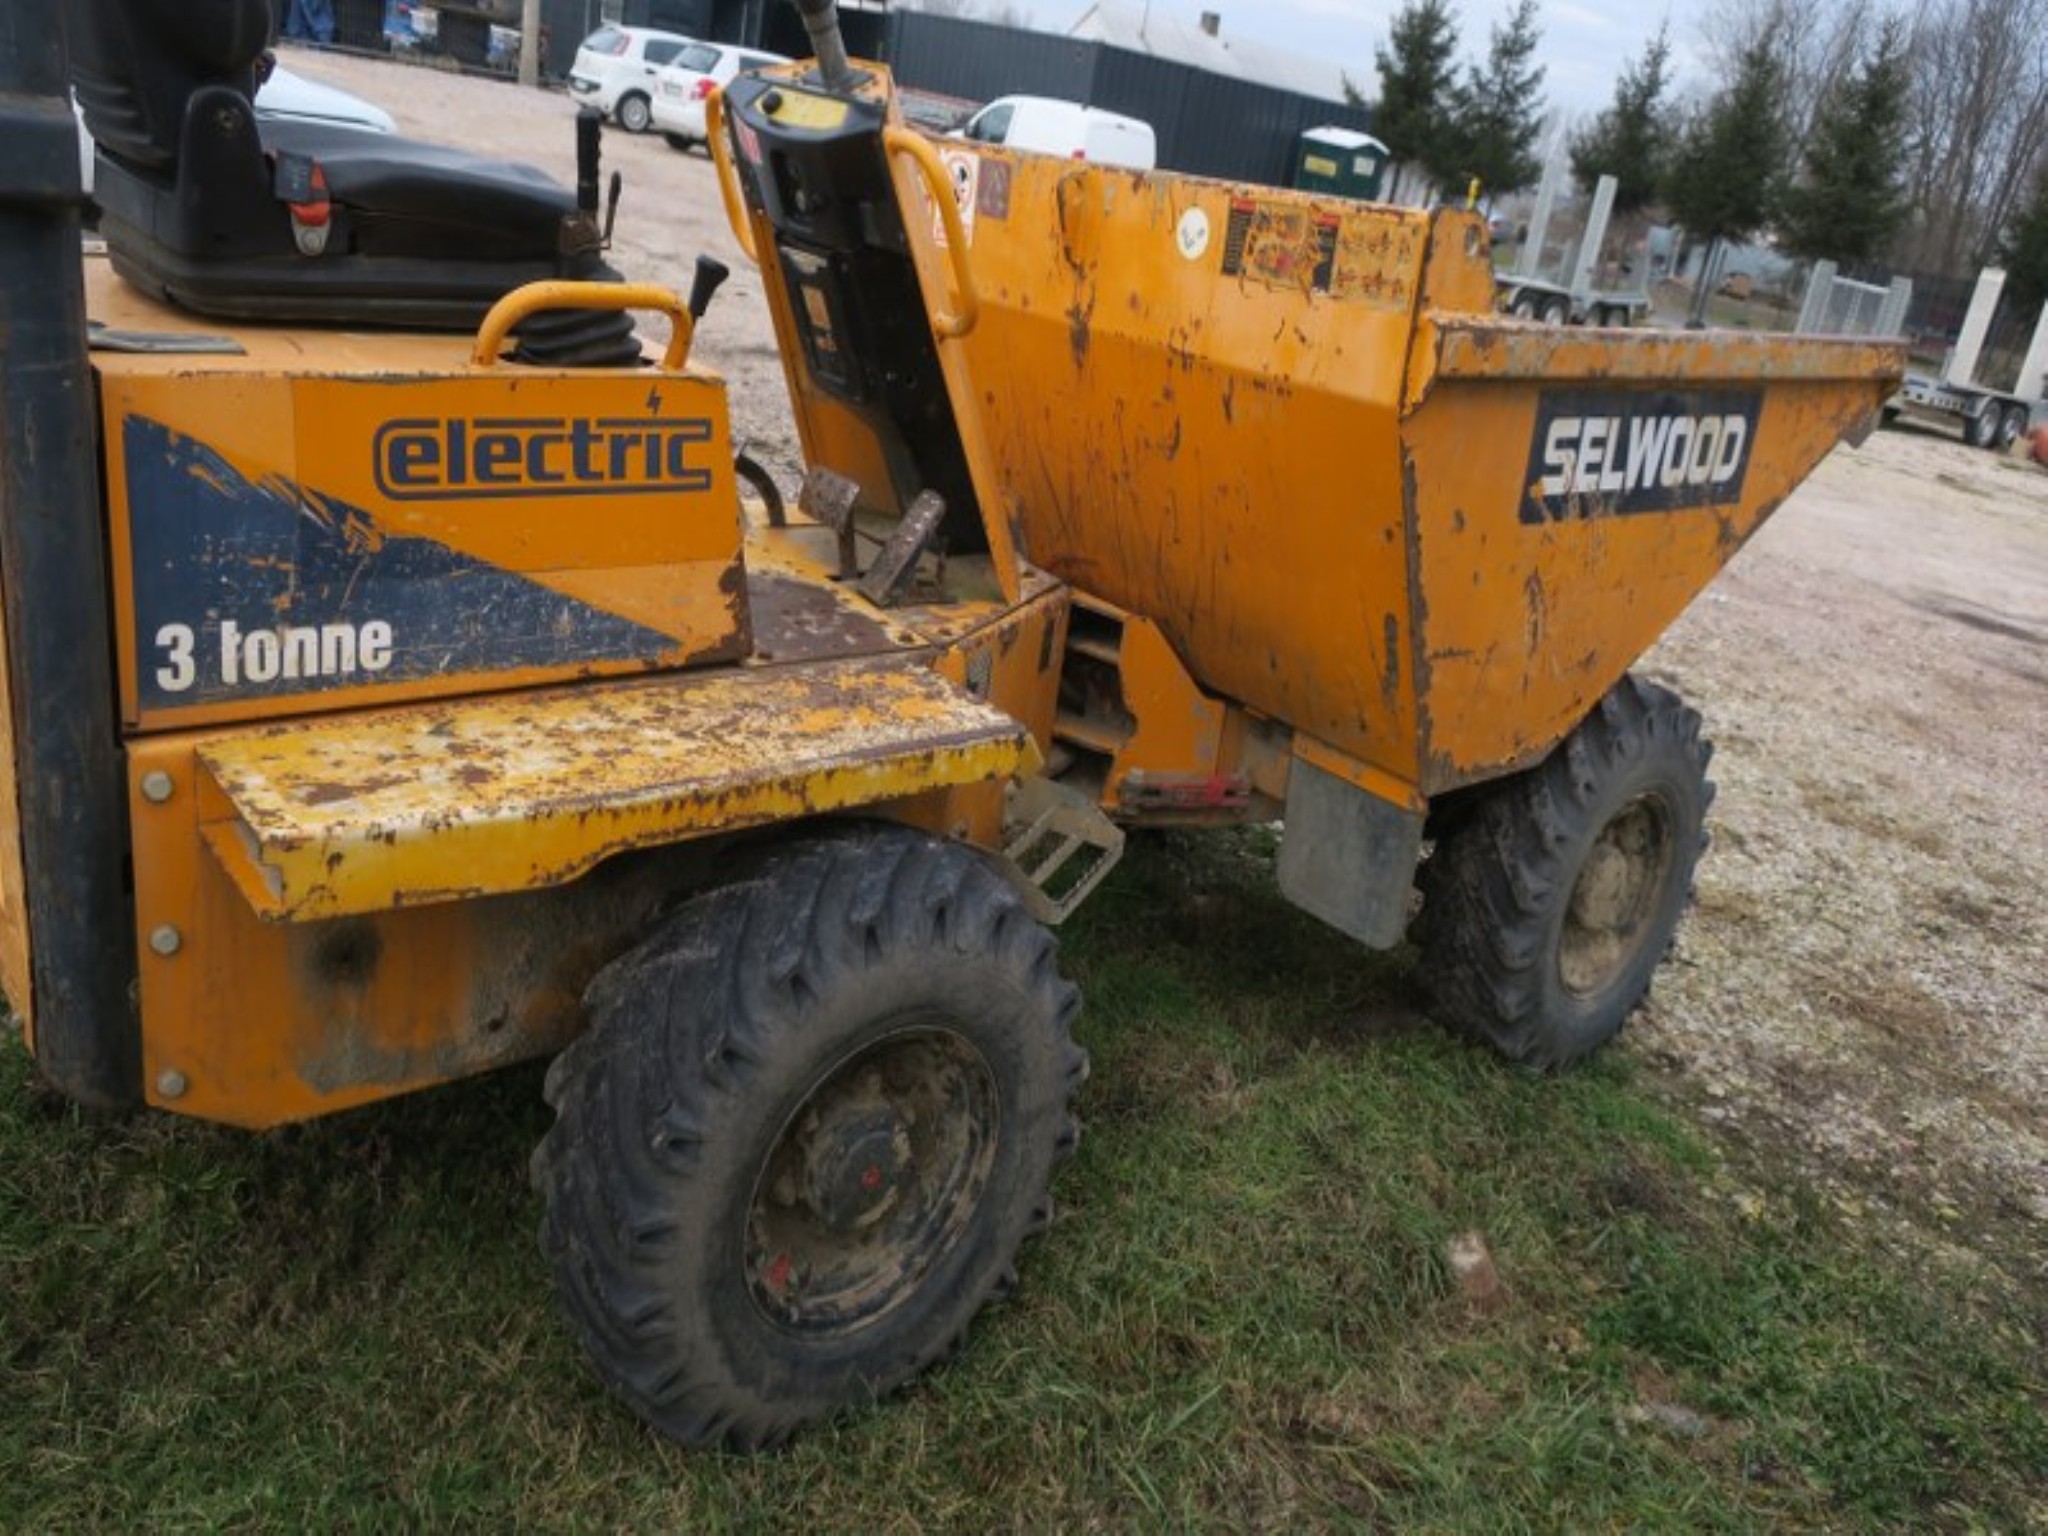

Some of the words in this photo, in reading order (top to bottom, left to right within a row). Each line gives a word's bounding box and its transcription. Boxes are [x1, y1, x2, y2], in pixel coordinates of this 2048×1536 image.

[381, 416, 713, 492] electric
[1542, 415, 1748, 496] SELWOOD
[155, 623, 196, 691] 3
[221, 620, 393, 684] tonne
